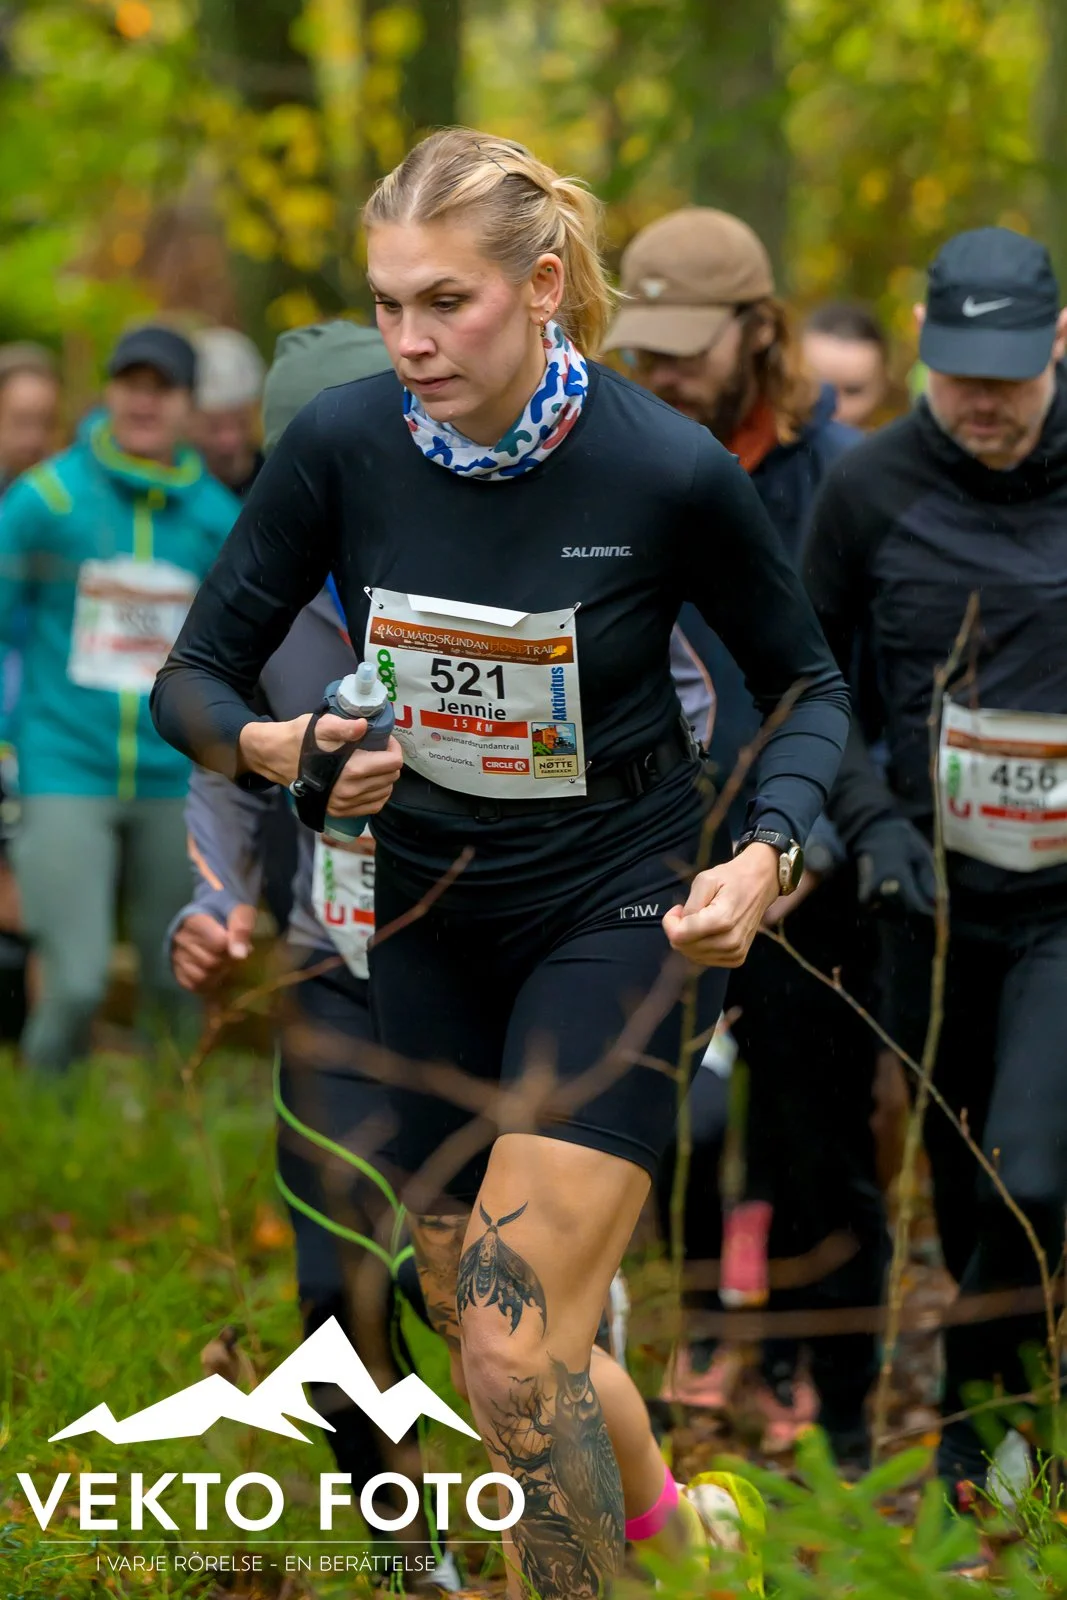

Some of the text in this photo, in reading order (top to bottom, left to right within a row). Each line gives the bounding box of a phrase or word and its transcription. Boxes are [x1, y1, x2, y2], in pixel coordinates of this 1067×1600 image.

[430, 657, 505, 700] 521
[550, 665, 567, 721] Aktivitus
[437, 697, 507, 721] Jennie
[476, 720, 493, 733] KM
[485, 761, 514, 769] CIRCLE
[539, 761, 573, 770] NØTTE
[989, 763, 1059, 794] 456
